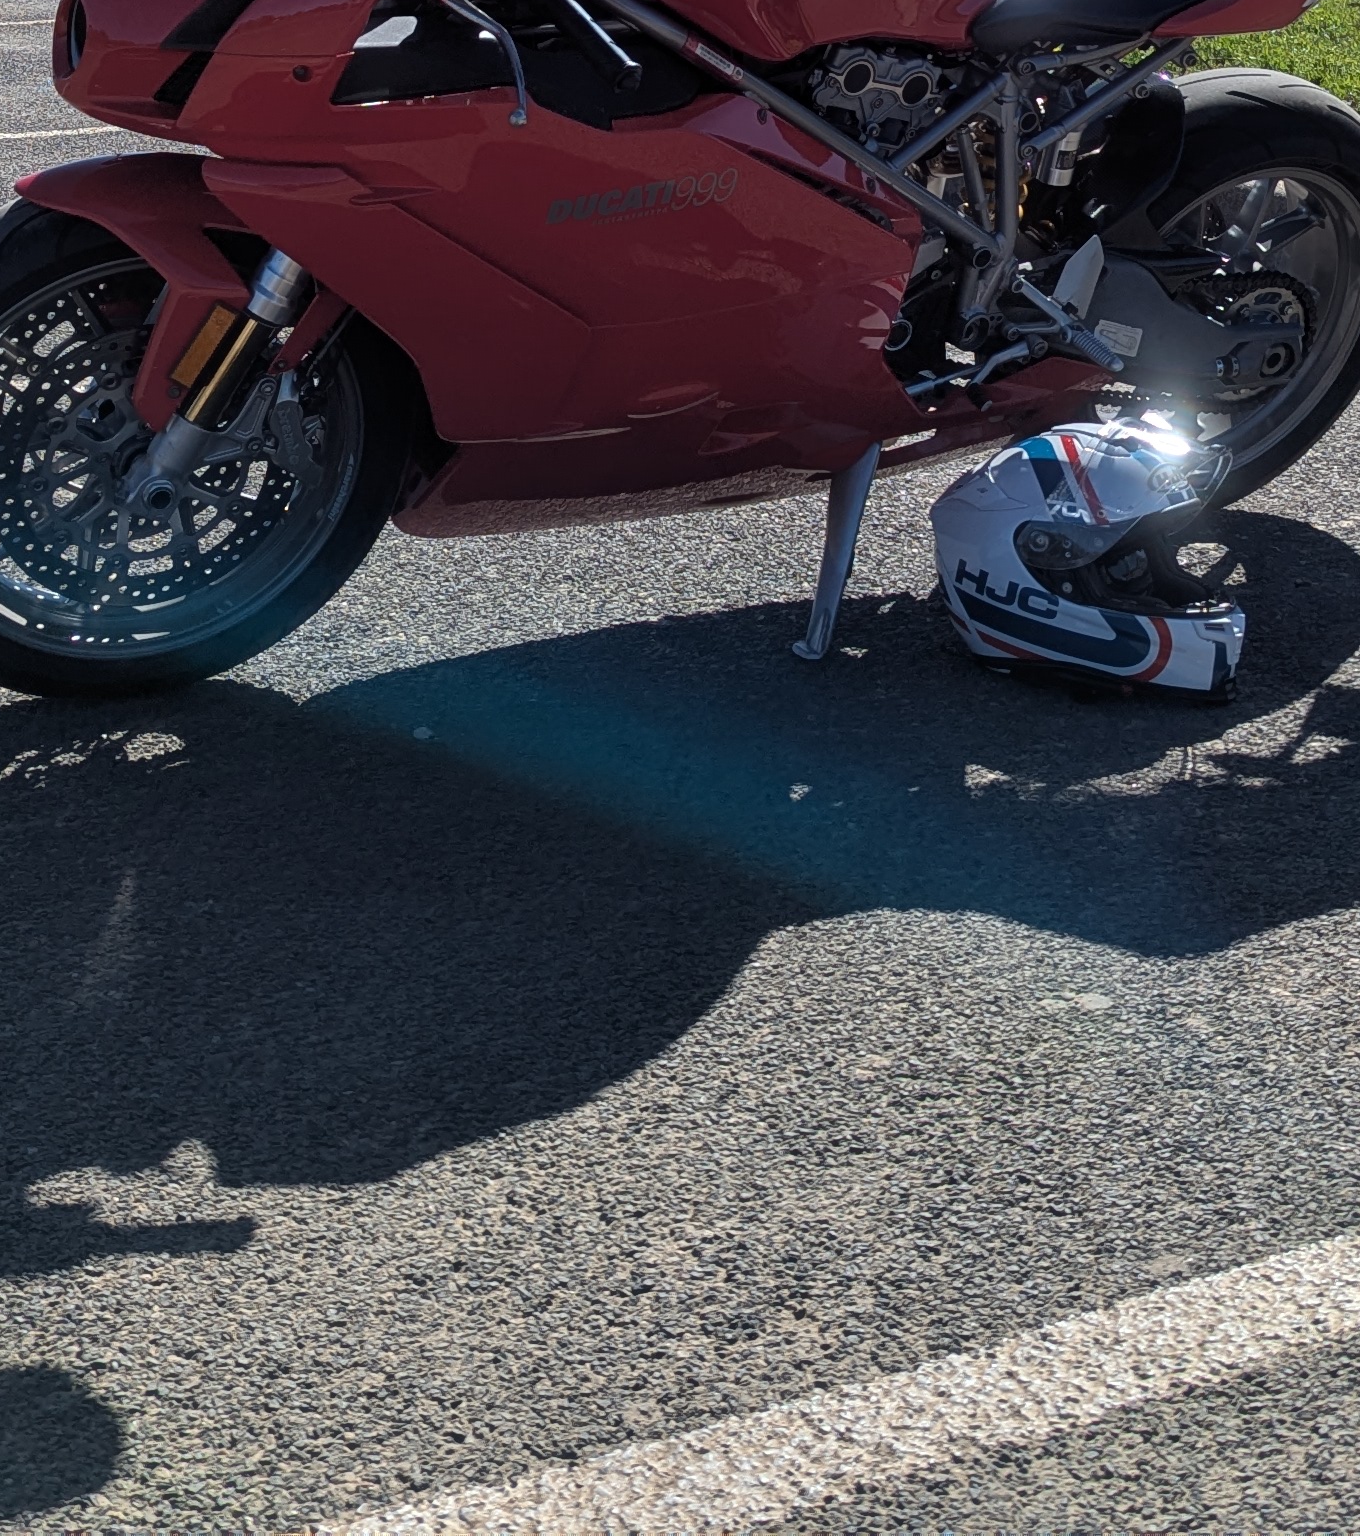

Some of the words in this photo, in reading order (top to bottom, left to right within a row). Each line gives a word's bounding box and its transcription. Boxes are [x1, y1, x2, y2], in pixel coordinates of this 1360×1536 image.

[545, 179, 677, 225] DUCATI
[671, 167, 739, 211] 999
[954, 558, 1060, 620] HJC
